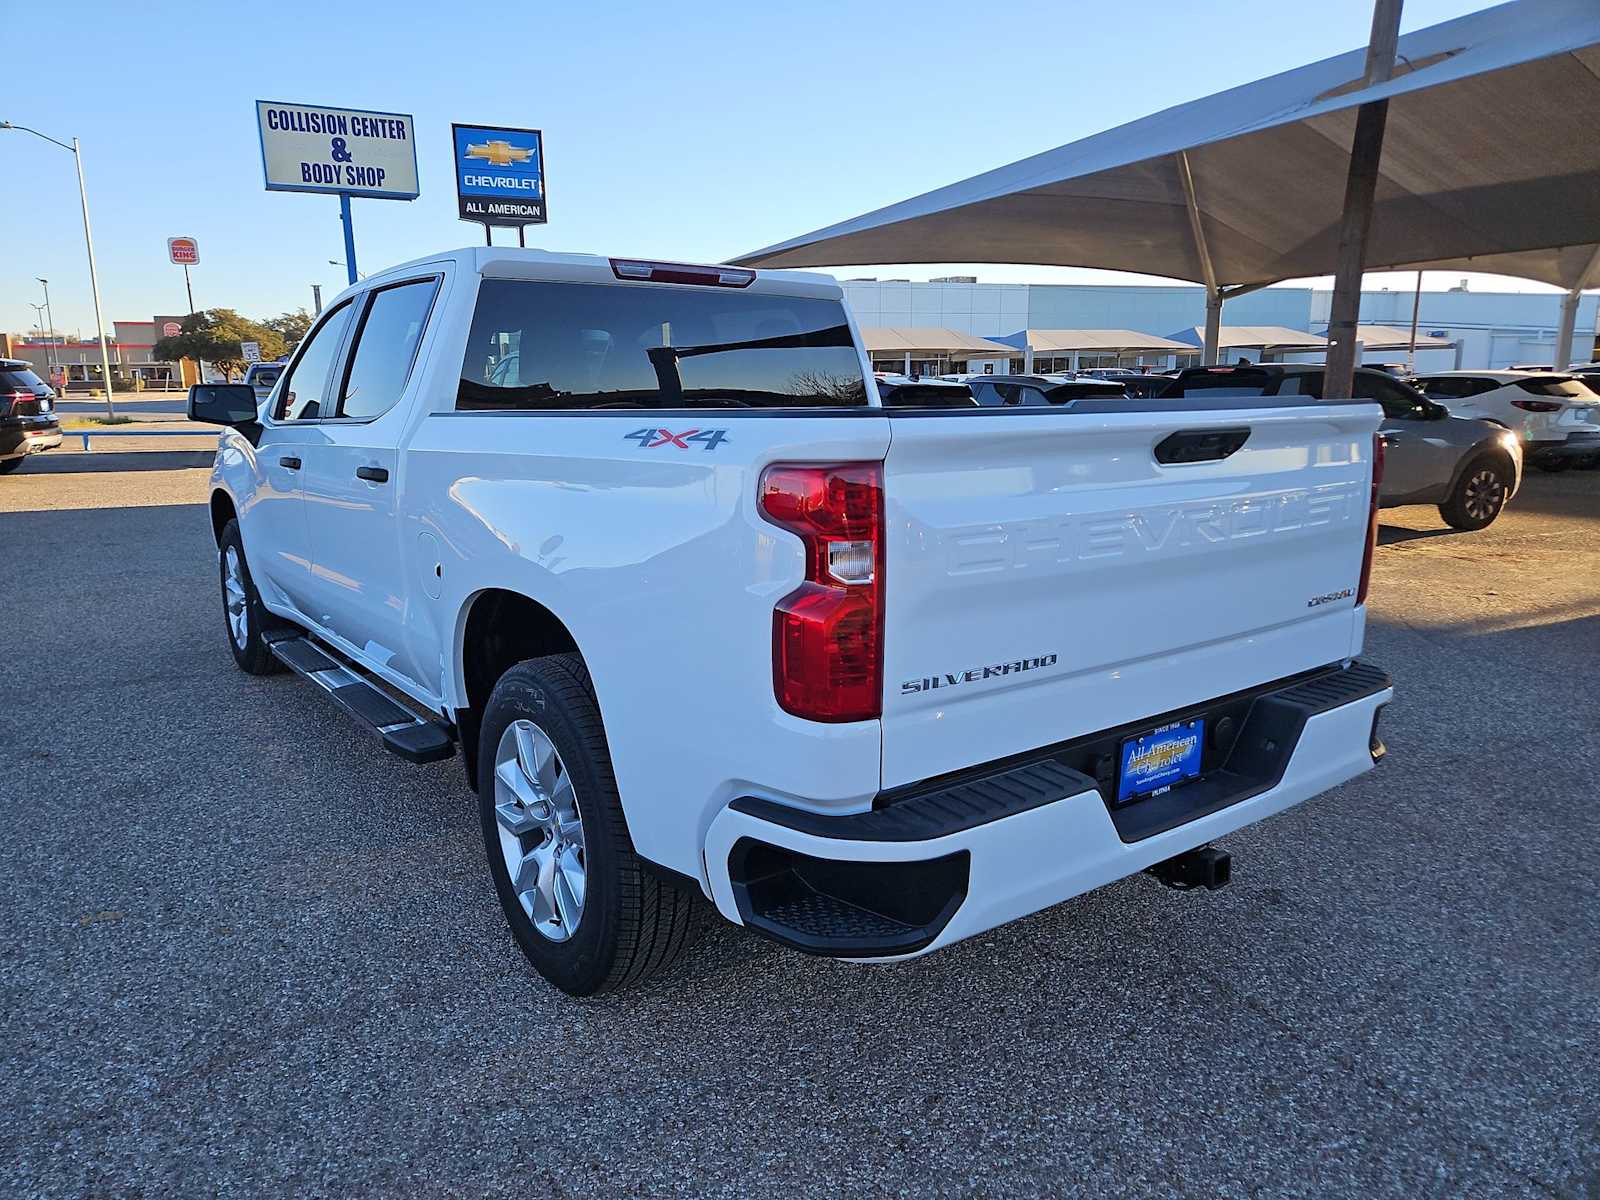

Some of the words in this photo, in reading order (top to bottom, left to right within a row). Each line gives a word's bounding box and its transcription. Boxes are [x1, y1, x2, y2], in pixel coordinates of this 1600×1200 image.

[267, 109, 347, 136] COLLISION
[351, 115, 406, 140] CENTER
[331, 137, 352, 163] &
[300, 162, 342, 185] BODY
[346, 166, 386, 187] SHOP
[464, 174, 537, 190] CHEVROLET
[465, 202, 485, 213] ALL
[487, 203, 540, 216] AMERICAN
[900, 653, 1058, 696] SILVERADO
[1127, 745, 1145, 764] All
[1147, 735, 1198, 758] American
